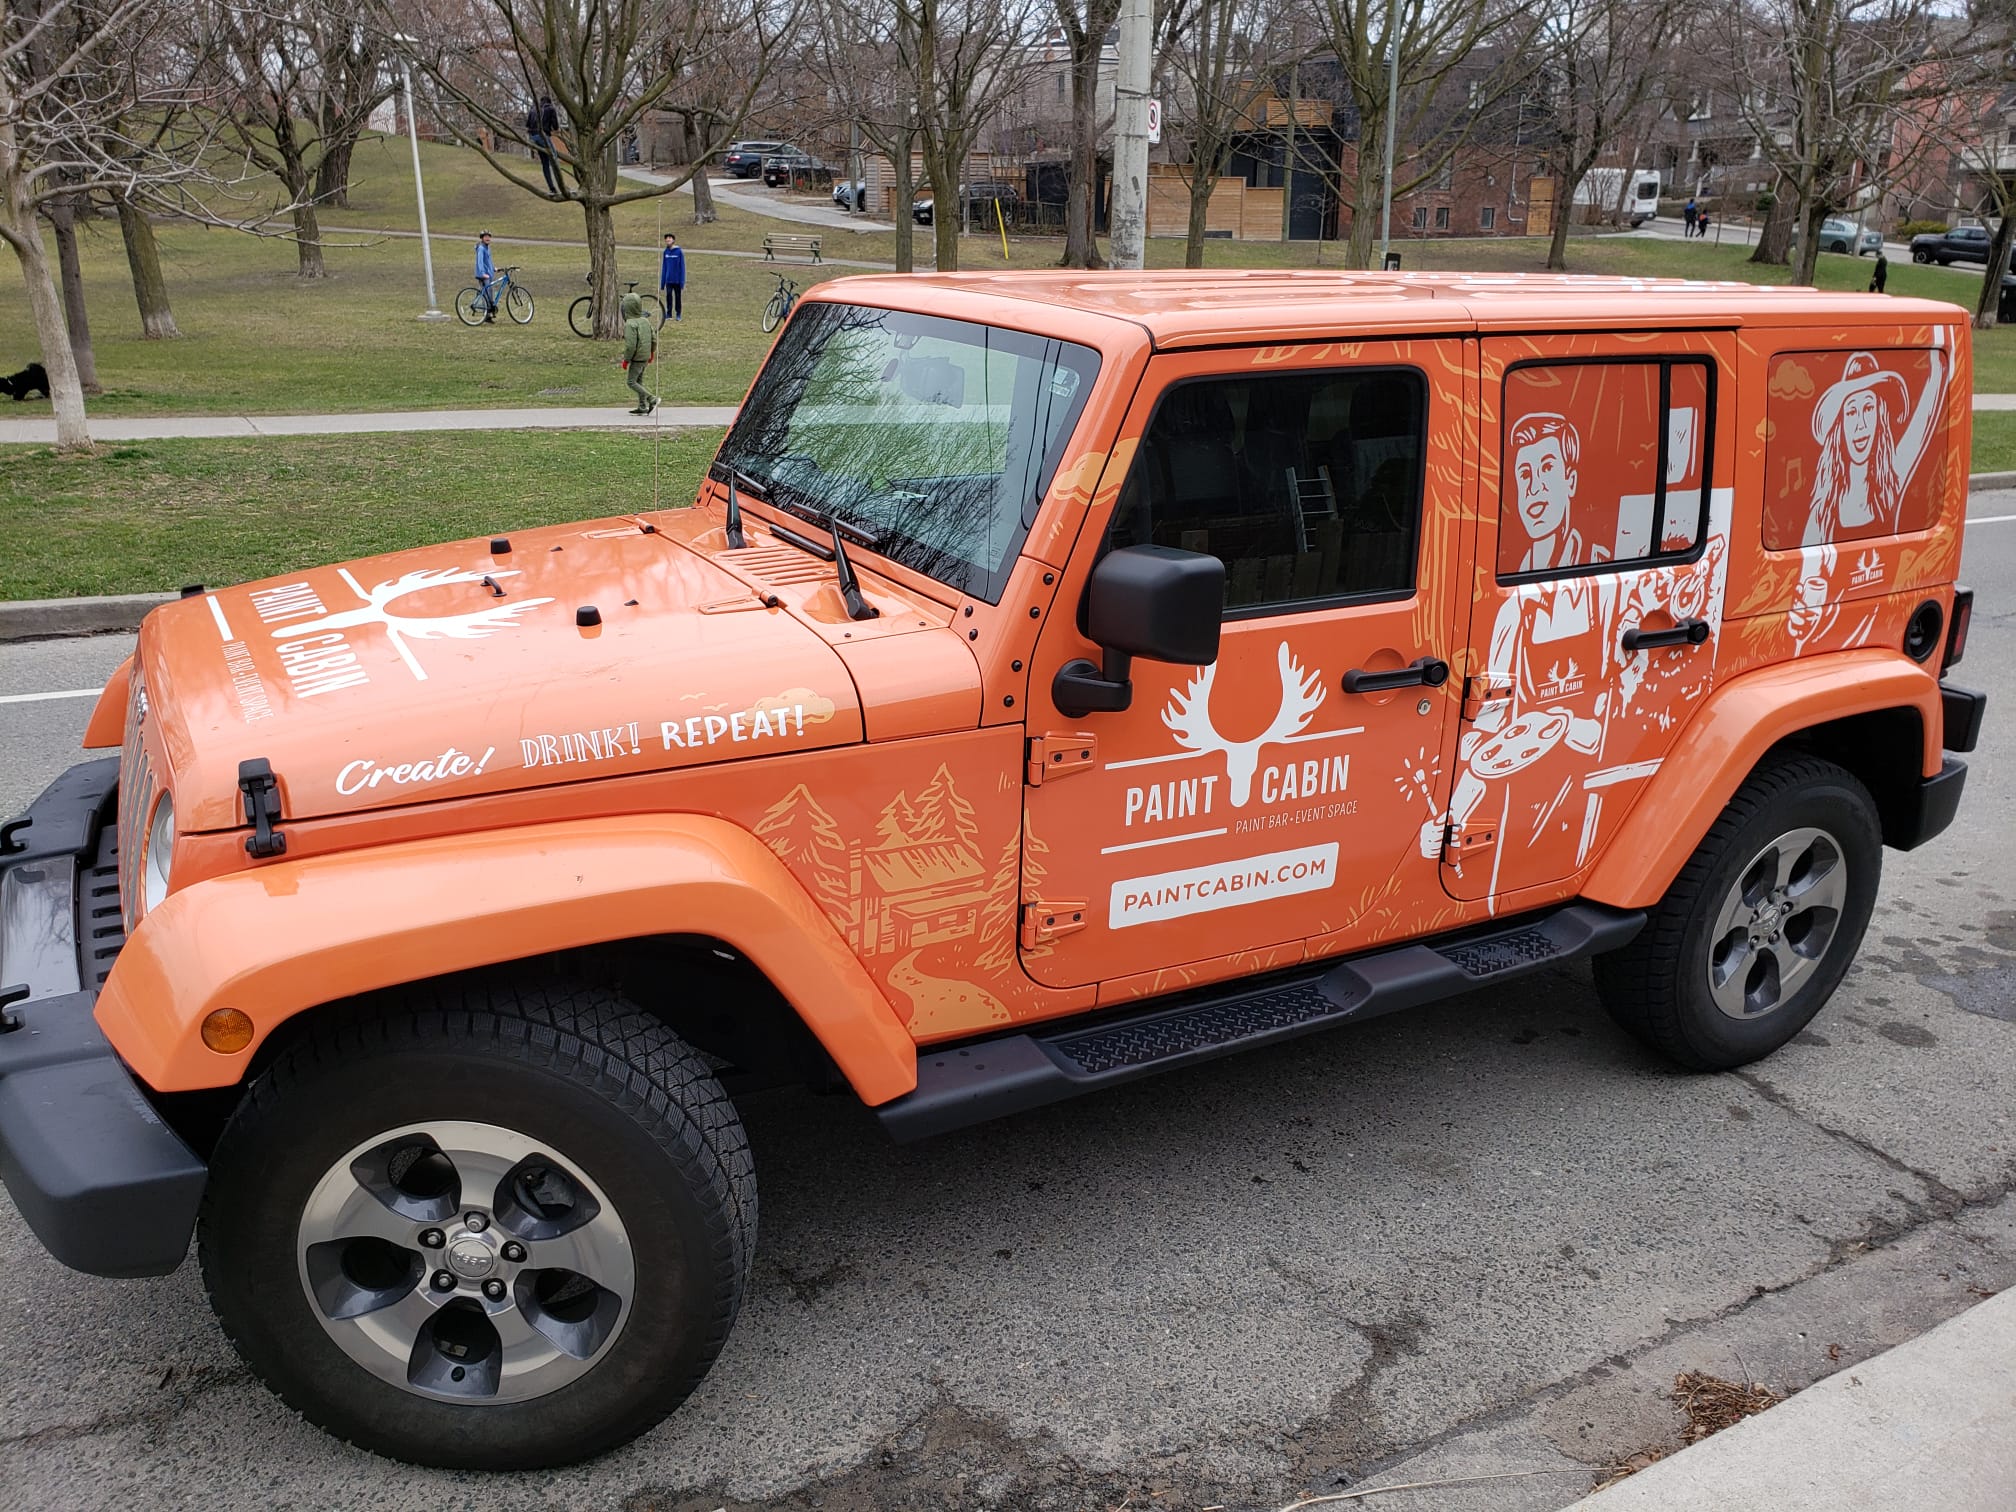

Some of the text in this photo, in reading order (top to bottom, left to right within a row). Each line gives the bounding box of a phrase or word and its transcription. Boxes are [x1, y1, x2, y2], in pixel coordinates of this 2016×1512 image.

[249, 582, 370, 699] PAINT CABIN
[1540, 679, 1583, 699] PAINT CABIN
[335, 704, 804, 795] Create! DRINK! REPEAT!
[1125, 754, 1350, 826] PAINT CABIN
[1235, 815, 1266, 834] PAINT
[1327, 800, 1358, 818] SPACE
[1124, 858, 1326, 912] PAINTCABIN.COM
